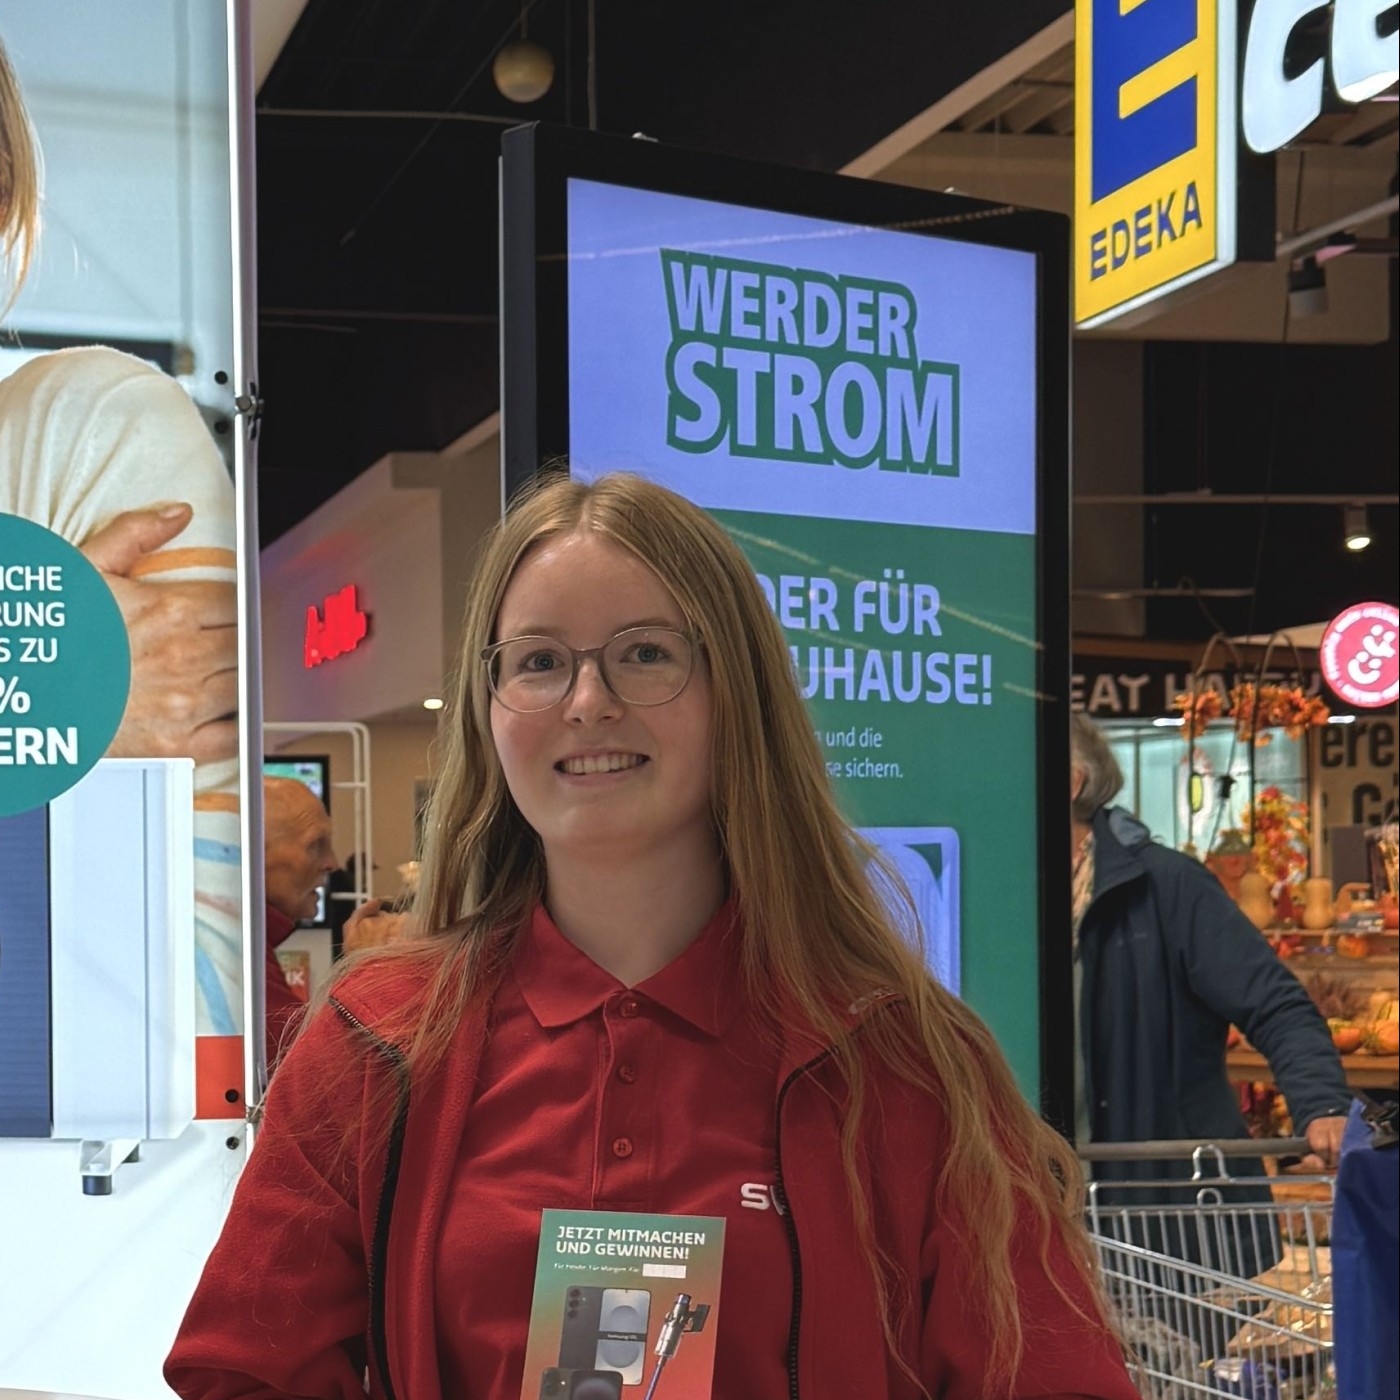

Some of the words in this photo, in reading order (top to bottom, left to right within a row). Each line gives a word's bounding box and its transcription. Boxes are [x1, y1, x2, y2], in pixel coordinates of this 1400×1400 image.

[1090, 181, 1202, 281] EDEKA
[670, 261, 912, 359] WERDER
[673, 341, 954, 467] STROM
[854, 568, 943, 637] FÜR
[19, 637, 59, 663] ZU
[790, 645, 993, 706] UHAUSE!
[1071, 673, 1150, 712] EAT
[826, 726, 855, 747] und
[859, 727, 883, 748] die
[845, 757, 904, 778] sichern.
[555, 1241, 591, 1255] UND
[594, 1243, 690, 1260] GEWINNEN!
[557, 1226, 605, 1241] JETZT
[607, 1228, 706, 1246] MITMACHEN
